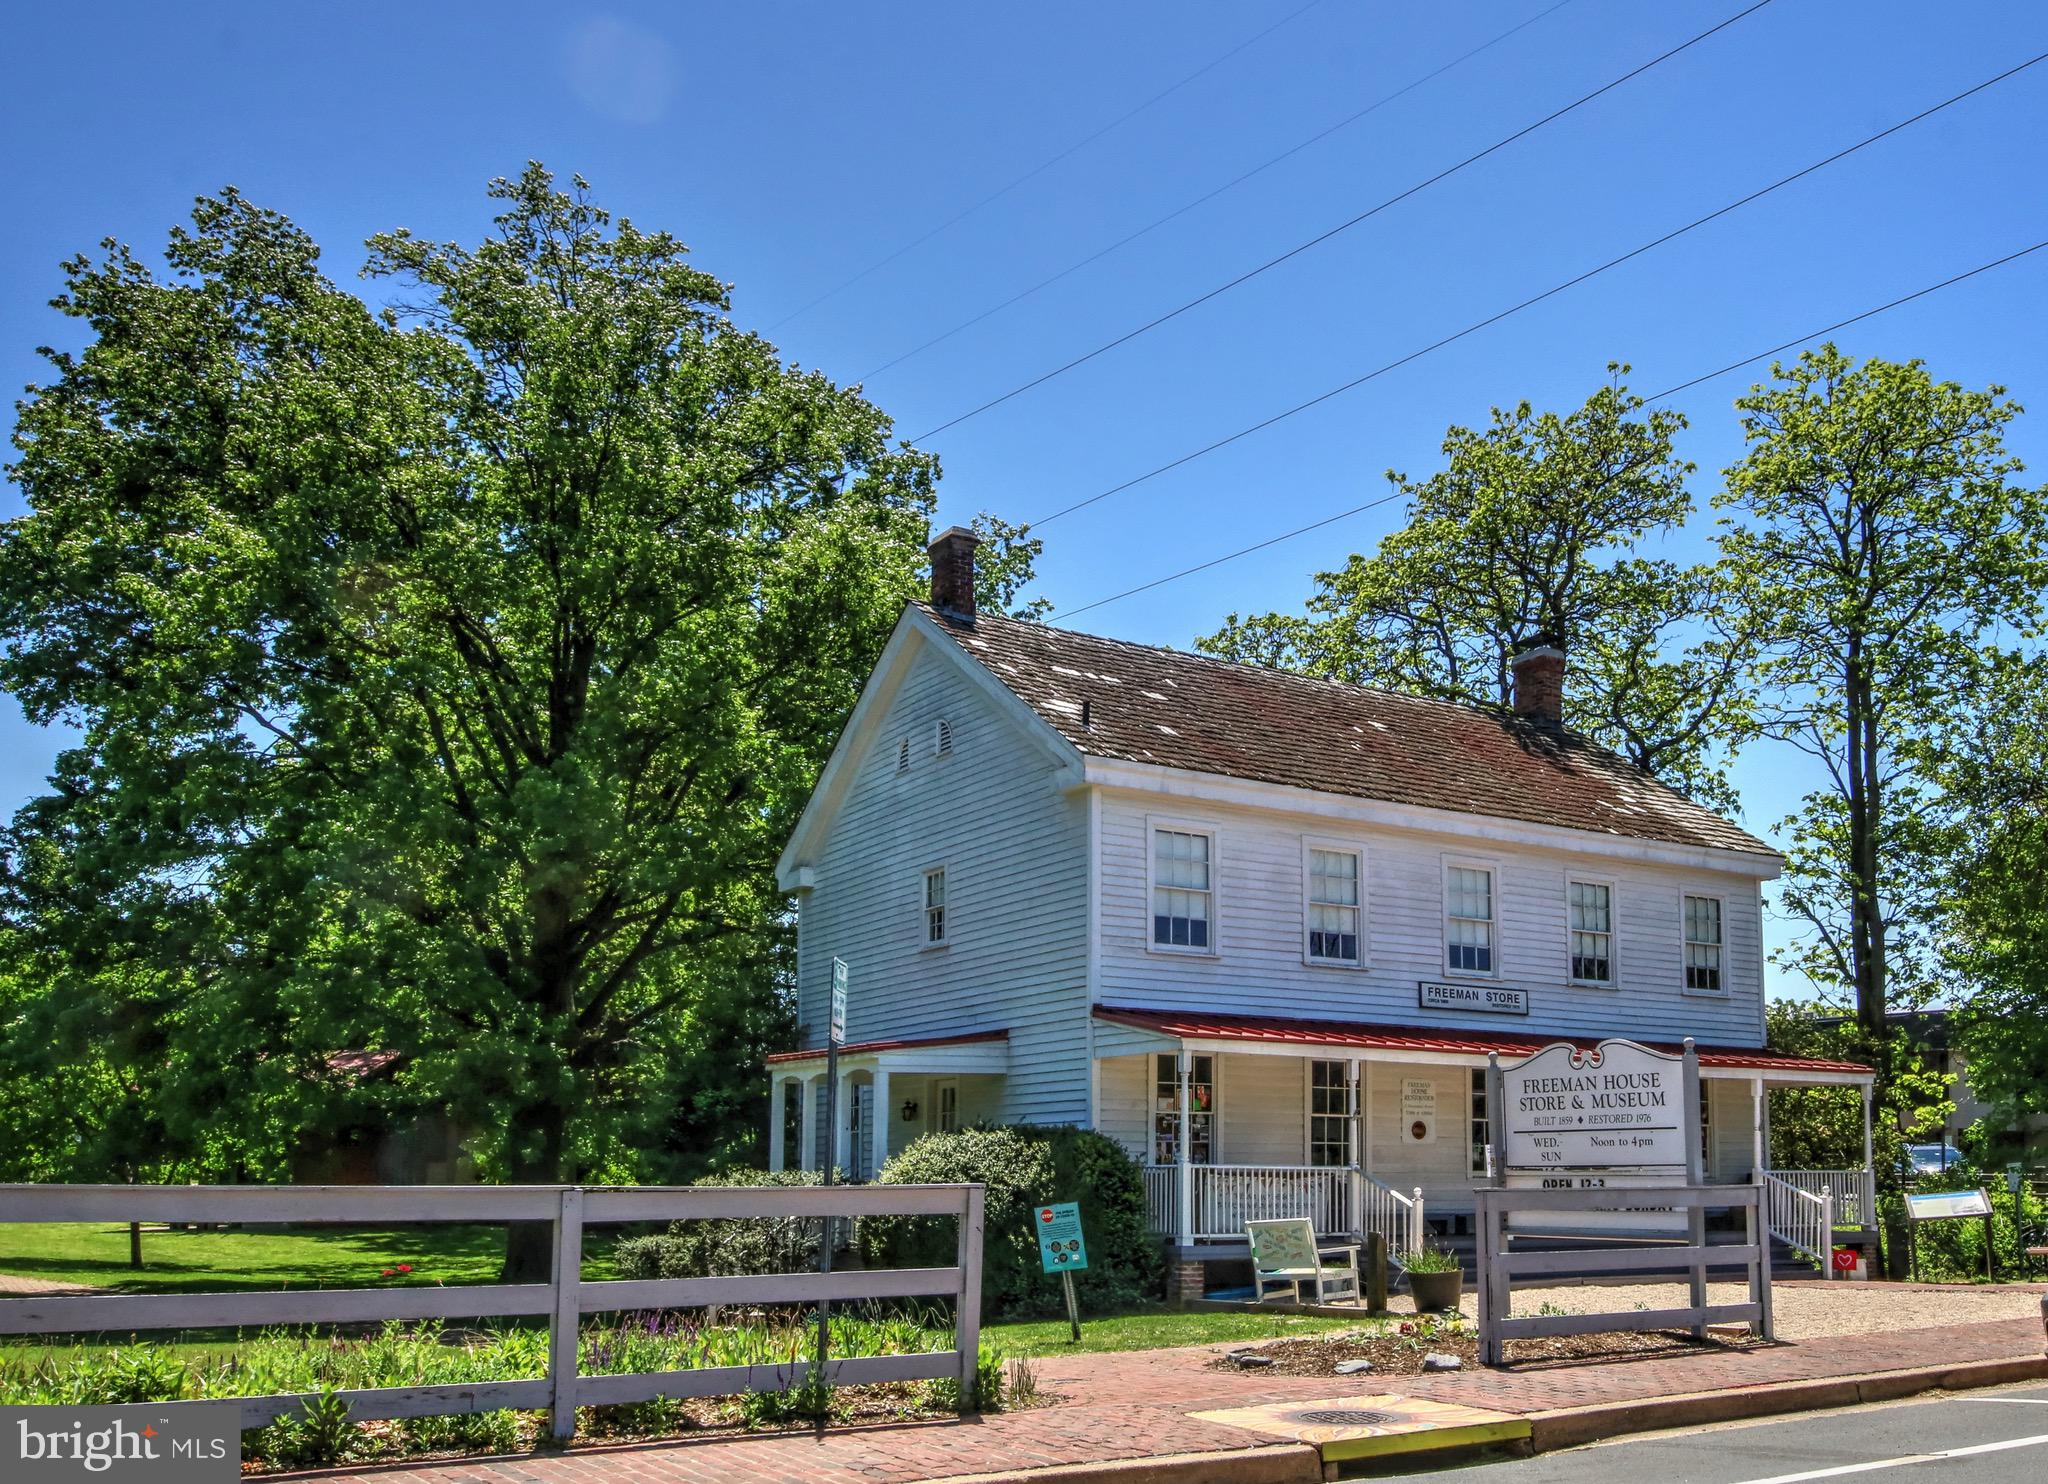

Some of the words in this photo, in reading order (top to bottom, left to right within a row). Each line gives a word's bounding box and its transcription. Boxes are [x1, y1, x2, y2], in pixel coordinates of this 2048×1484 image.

[1428, 987, 1479, 1000] FREEMAN
[1486, 992, 1520, 1003] STORE
[1523, 1075, 1598, 1094] FREEMAN
[1604, 1072, 1661, 1090] HOUSE
[1519, 1095, 1566, 1112] STORE
[1571, 1095, 1585, 1110] &
[1591, 1091, 1666, 1109] MUSEUM
[1533, 1116, 1556, 1126] BUILT
[1558, 1115, 1573, 1126] 1859
[1588, 1114, 1633, 1124] RESTORED
[1636, 1113, 1651, 1123] 1976
[1590, 1136, 1615, 1147] Noon
[1619, 1136, 1628, 1146] to
[1631, 1136, 1654, 1148] 4pm
[1541, 1152, 1562, 1161] SUN
